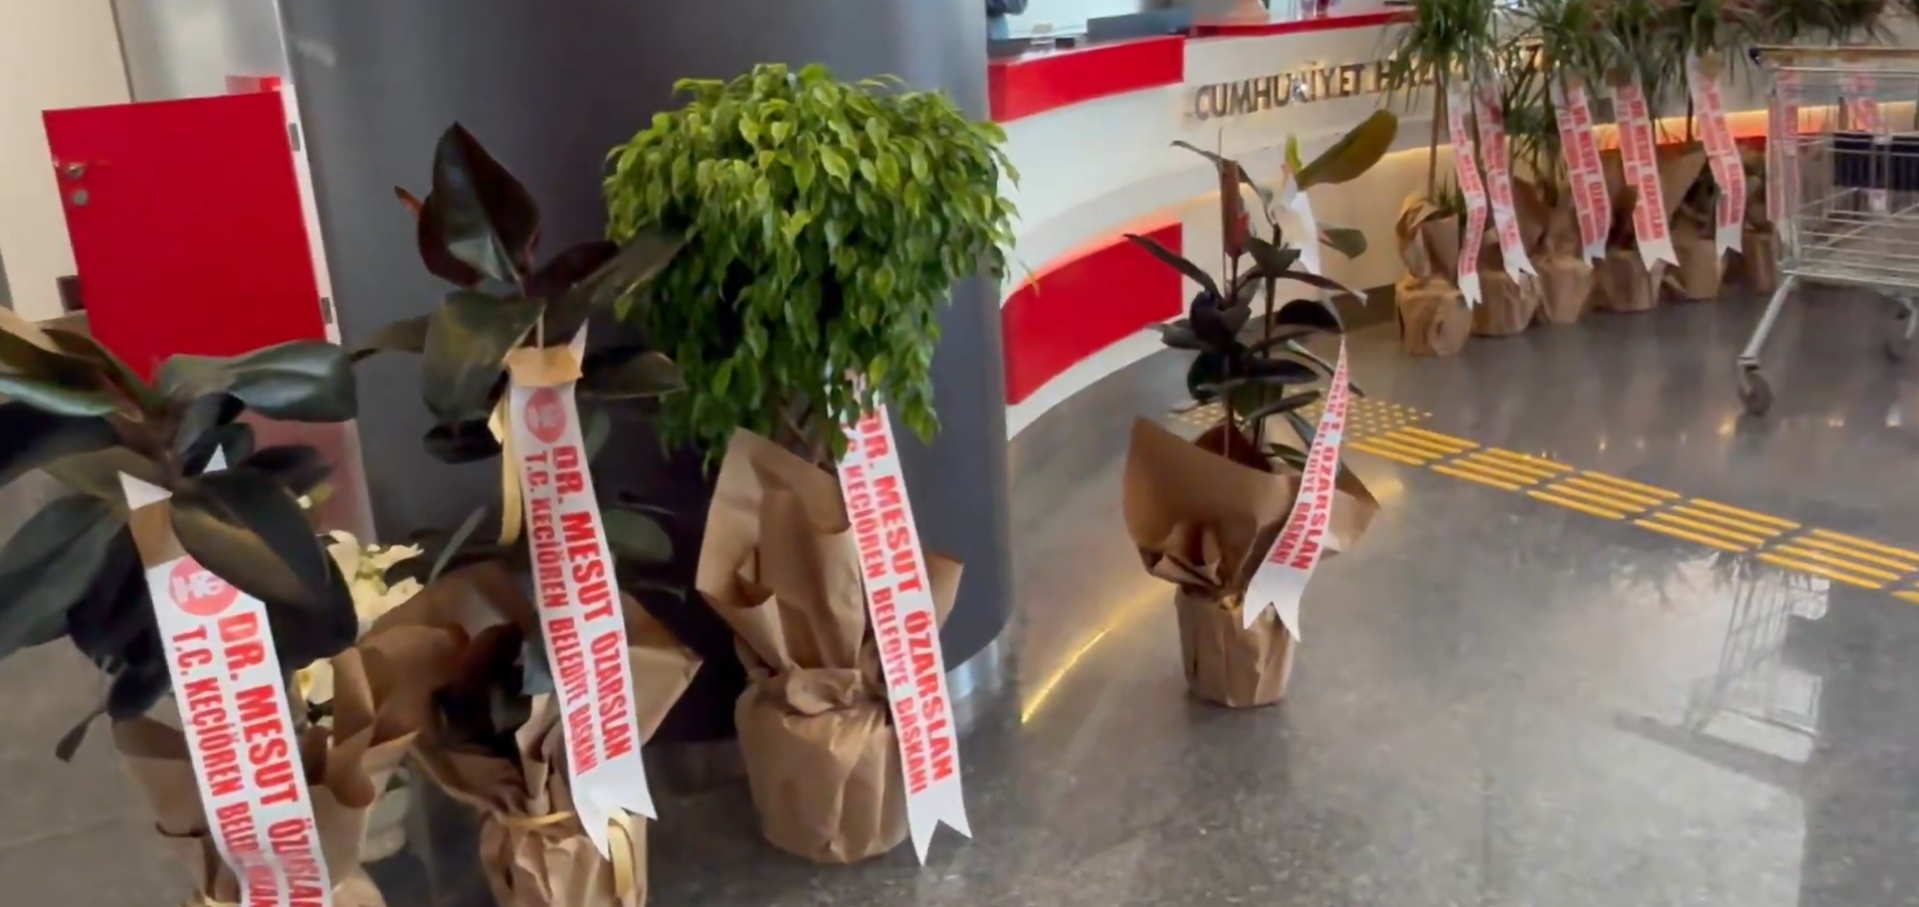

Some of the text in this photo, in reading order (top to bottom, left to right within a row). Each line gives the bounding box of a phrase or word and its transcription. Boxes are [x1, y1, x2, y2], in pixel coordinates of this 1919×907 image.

[525, 450, 549, 492] T.C.
[172, 624, 213, 676] T.C.
[217, 611, 266, 681] DR.
[552, 445, 632, 760] DR. MESUT ÖZARSLAN
[872, 475, 922, 593] MESUT
[904, 610, 953, 782] ÖZARSLAN
[235, 684, 299, 806] MESUT
